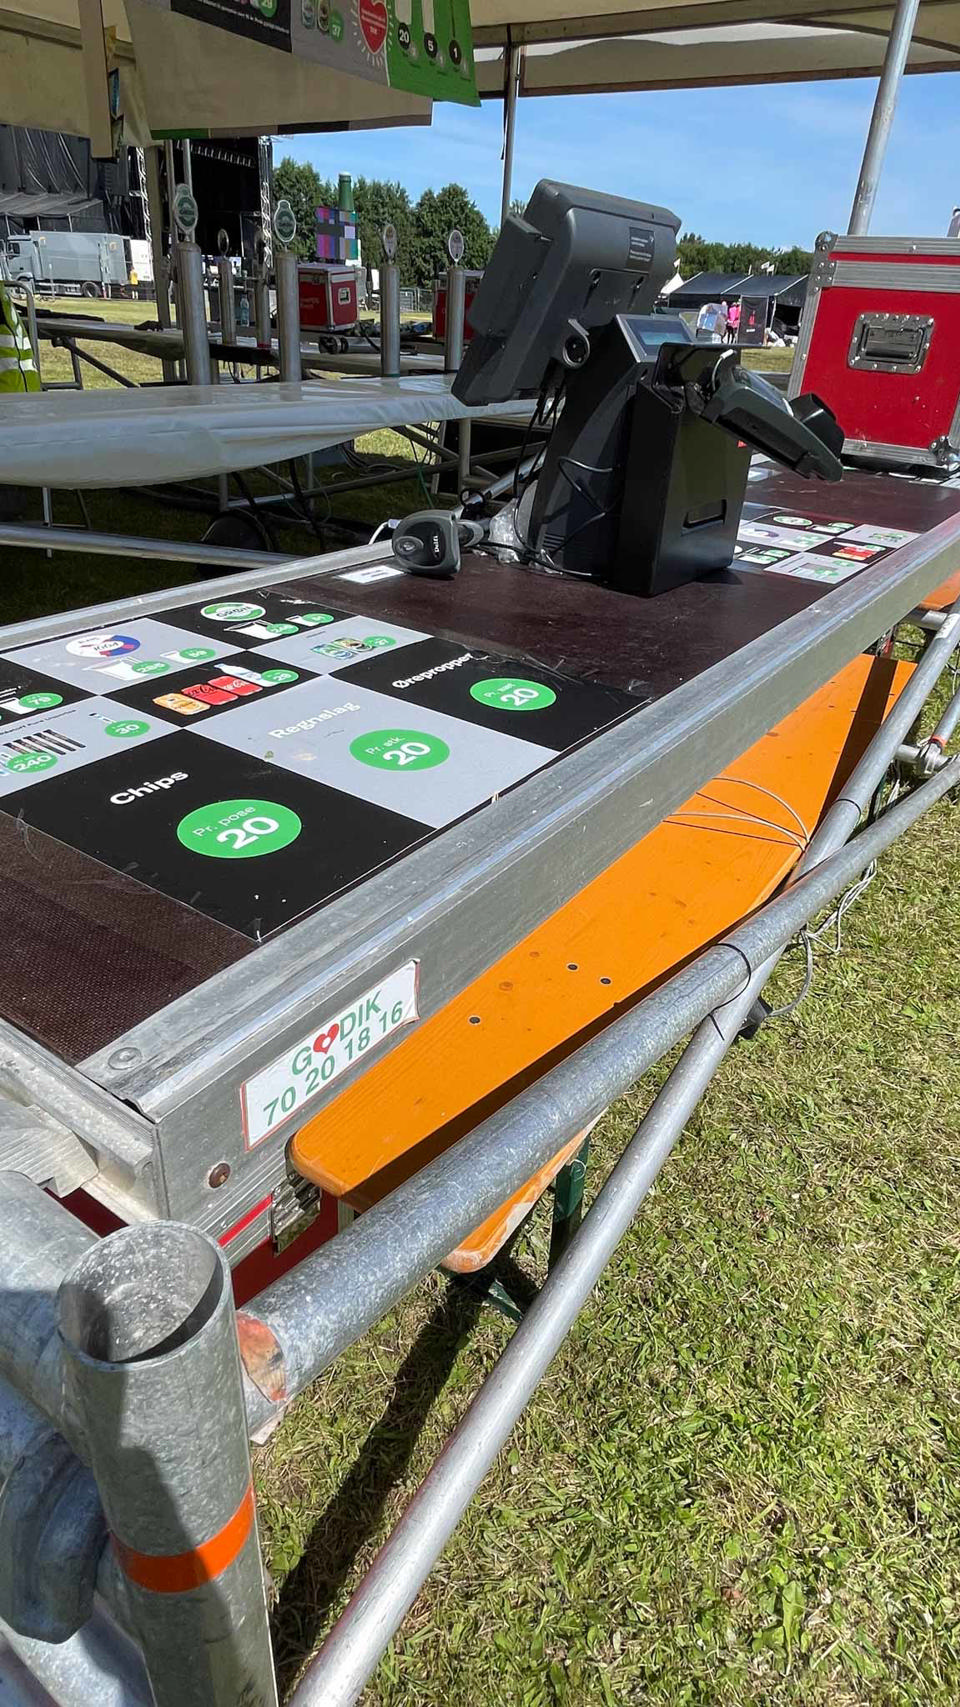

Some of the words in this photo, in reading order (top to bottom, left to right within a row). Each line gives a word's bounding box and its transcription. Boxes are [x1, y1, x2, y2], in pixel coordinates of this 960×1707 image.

[399, 29, 410, 44] 20
[427, 40, 434, 51] 5
[391, 652, 474, 690] Ørepropper
[500, 687, 540, 707] 20
[115, 723, 141, 736] 30
[268, 701, 361, 739] Regnslag
[13, 755, 52, 771] 240
[382, 741, 432, 766] 20
[109, 770, 189, 806] Chips
[192, 823, 218, 838] Pr.
[218, 806, 257, 828] pose
[216, 816, 280, 850] 20
[262, 1085, 297, 1127] 70
[305, 1055, 336, 1096] 20
[344, 1027, 371, 1061] 18
[379, 1000, 404, 1033] 16
